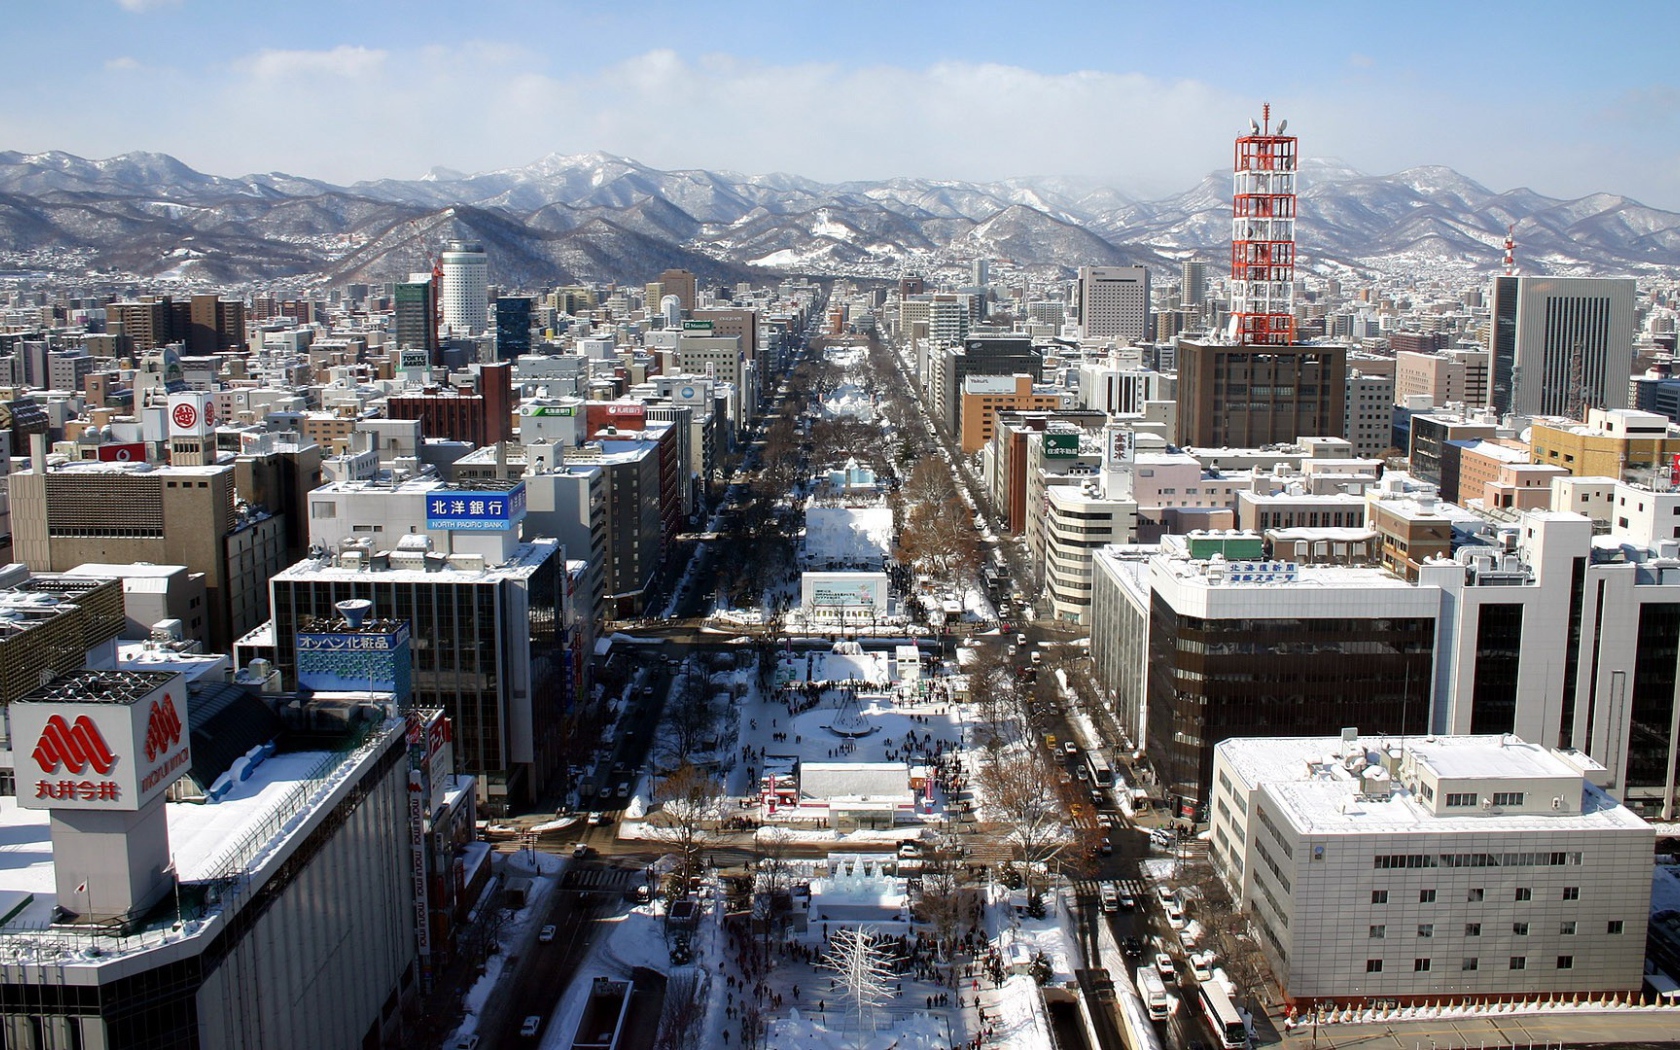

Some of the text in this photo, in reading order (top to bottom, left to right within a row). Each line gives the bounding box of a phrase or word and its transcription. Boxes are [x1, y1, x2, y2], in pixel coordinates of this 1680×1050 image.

[432, 500, 503, 515] 北洋銀行
[300, 636, 389, 649] オッペン化粧品
[35, 780, 117, 800] 丸井今井
